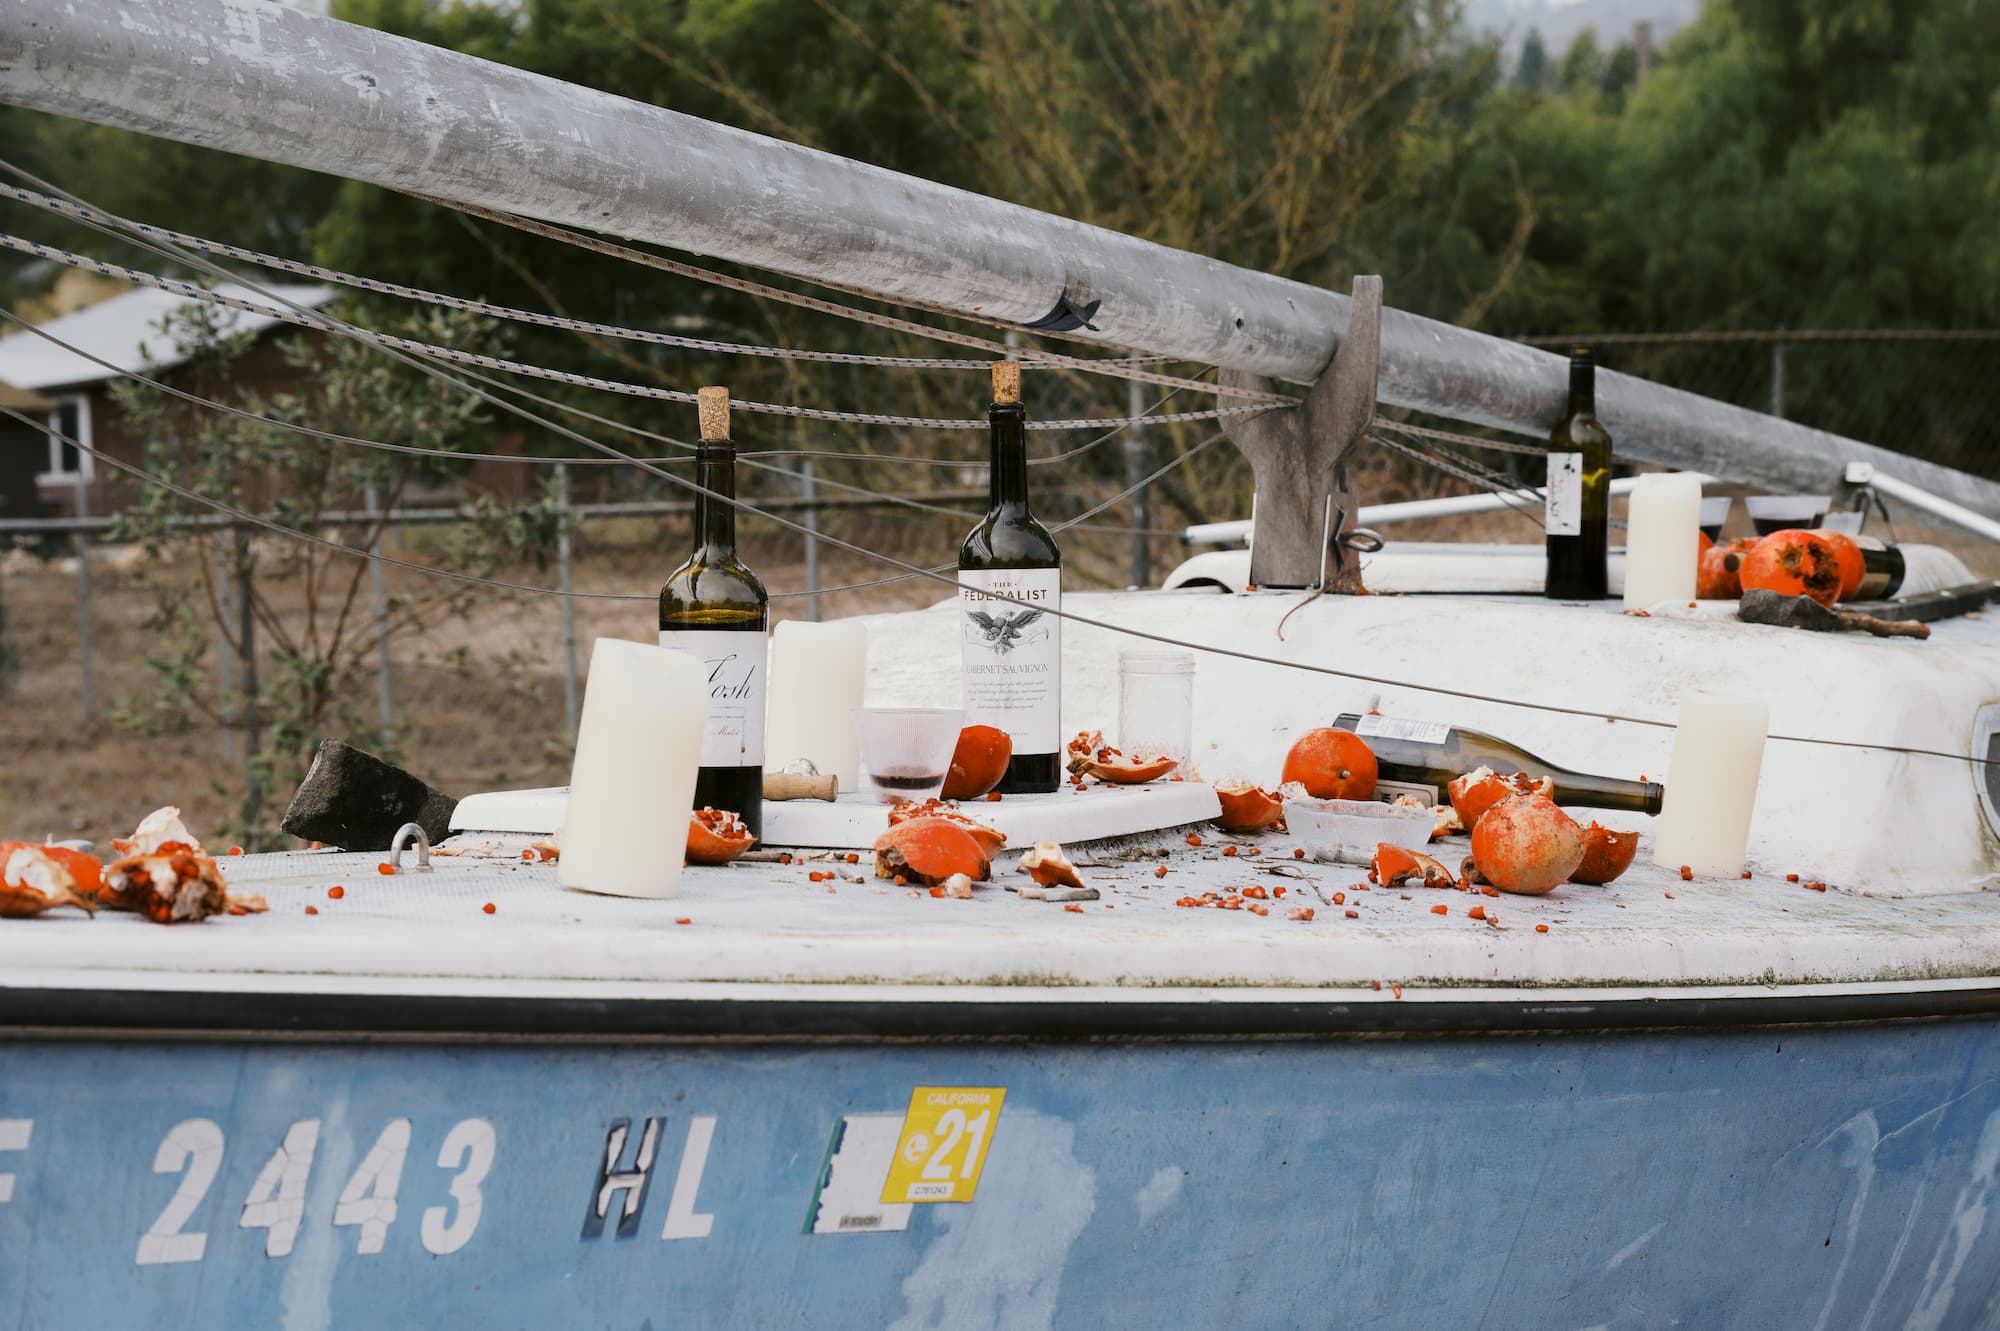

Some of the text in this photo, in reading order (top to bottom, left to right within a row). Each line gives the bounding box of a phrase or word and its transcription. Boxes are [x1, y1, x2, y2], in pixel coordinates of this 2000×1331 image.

[964, 589, 1047, 601] FEDERALIST
[1002, 663, 1049, 675] SAUVIGNON
[927, 1092, 991, 1105] CALIFORNIA
[921, 1108, 992, 1179] 21
[135, 1117, 497, 1266] 2443
[579, 1116, 718, 1242] HL
